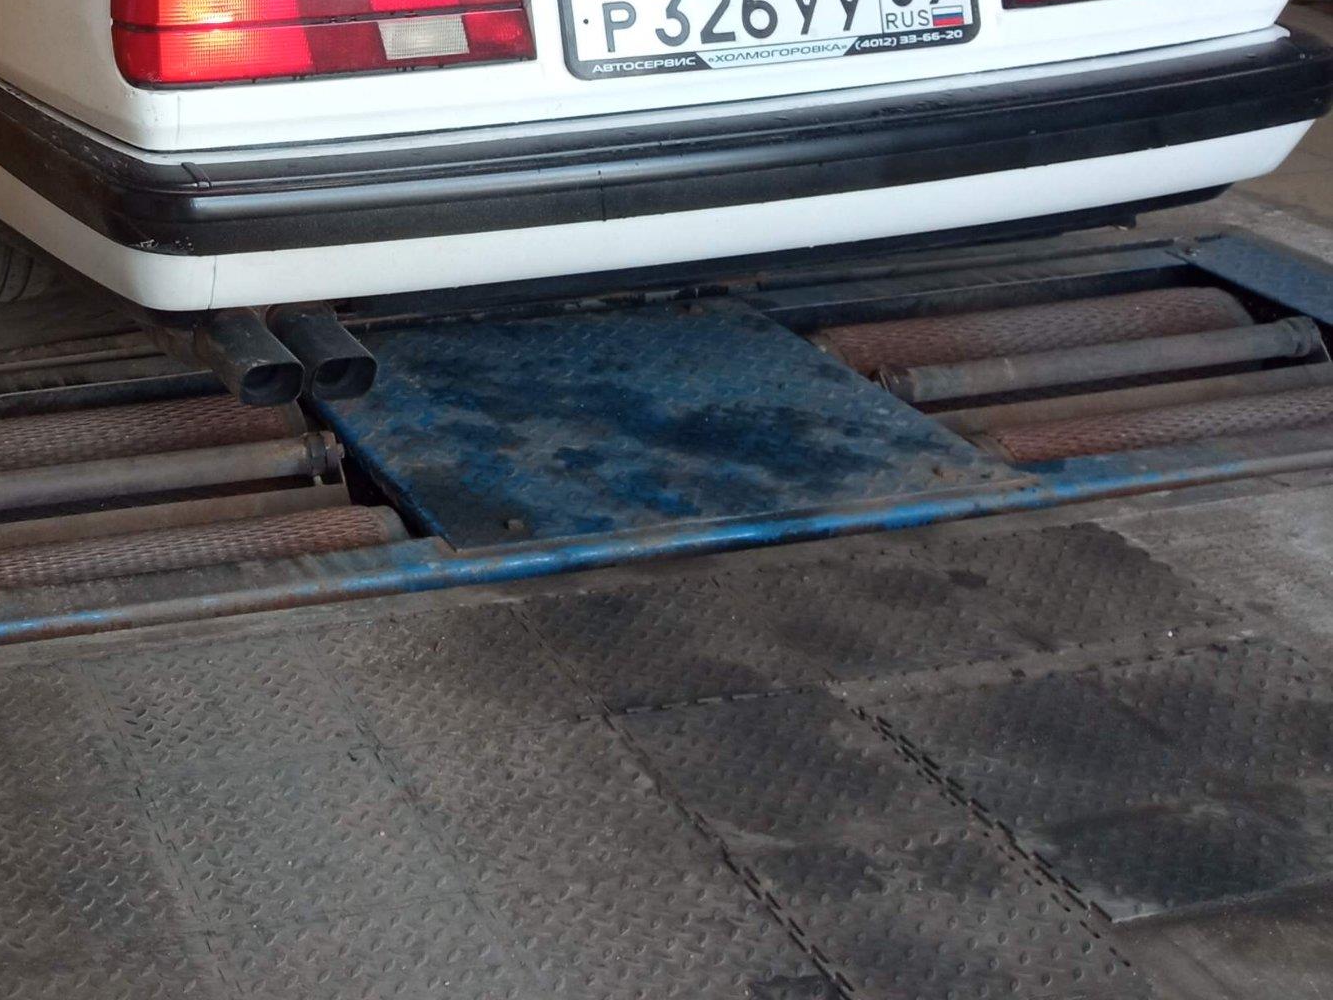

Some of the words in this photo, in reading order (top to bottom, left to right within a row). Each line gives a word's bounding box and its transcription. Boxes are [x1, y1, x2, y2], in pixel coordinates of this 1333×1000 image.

[885, 8, 931, 30] RUS
[591, 55, 697, 74] АВТОСЕРВИС
[708, 43, 849, 64] «ХОЛМОГОРОВКА»
[854, 36, 898, 51] (4012)
[899, 29, 964, 46] 33-66-20
